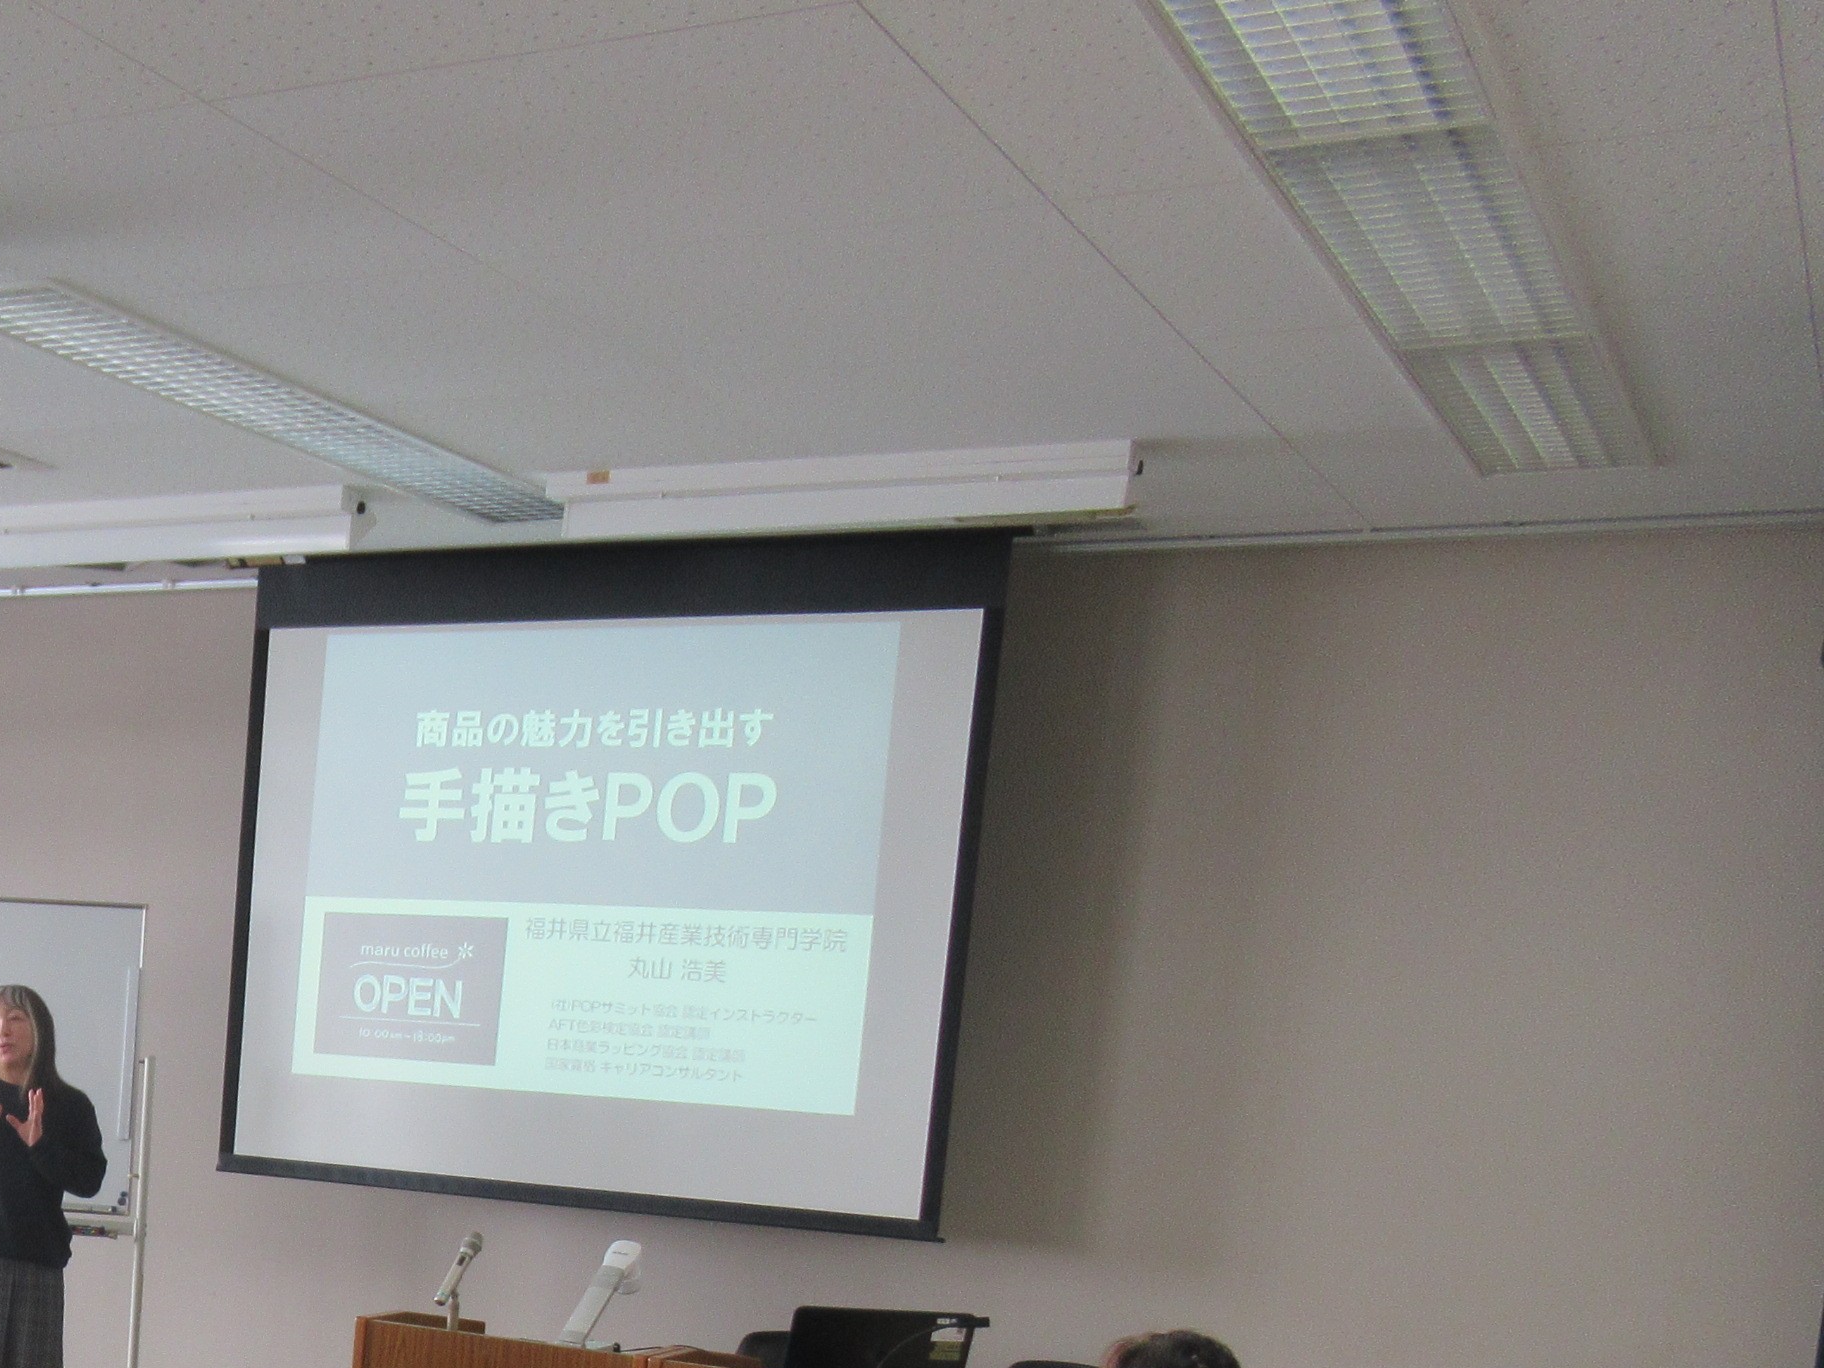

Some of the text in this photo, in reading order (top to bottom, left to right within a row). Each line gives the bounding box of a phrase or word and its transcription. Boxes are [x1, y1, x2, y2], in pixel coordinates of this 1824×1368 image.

[415, 706, 774, 750] 商品の魅力を引き出す
[398, 767, 779, 845] 手描きPOP
[360, 942, 449, 959] maru coffee
[524, 916, 849, 953] 福井県立福井産業技術専門学院
[627, 956, 674, 980] 丸山
[353, 973, 464, 1019] OPEN
